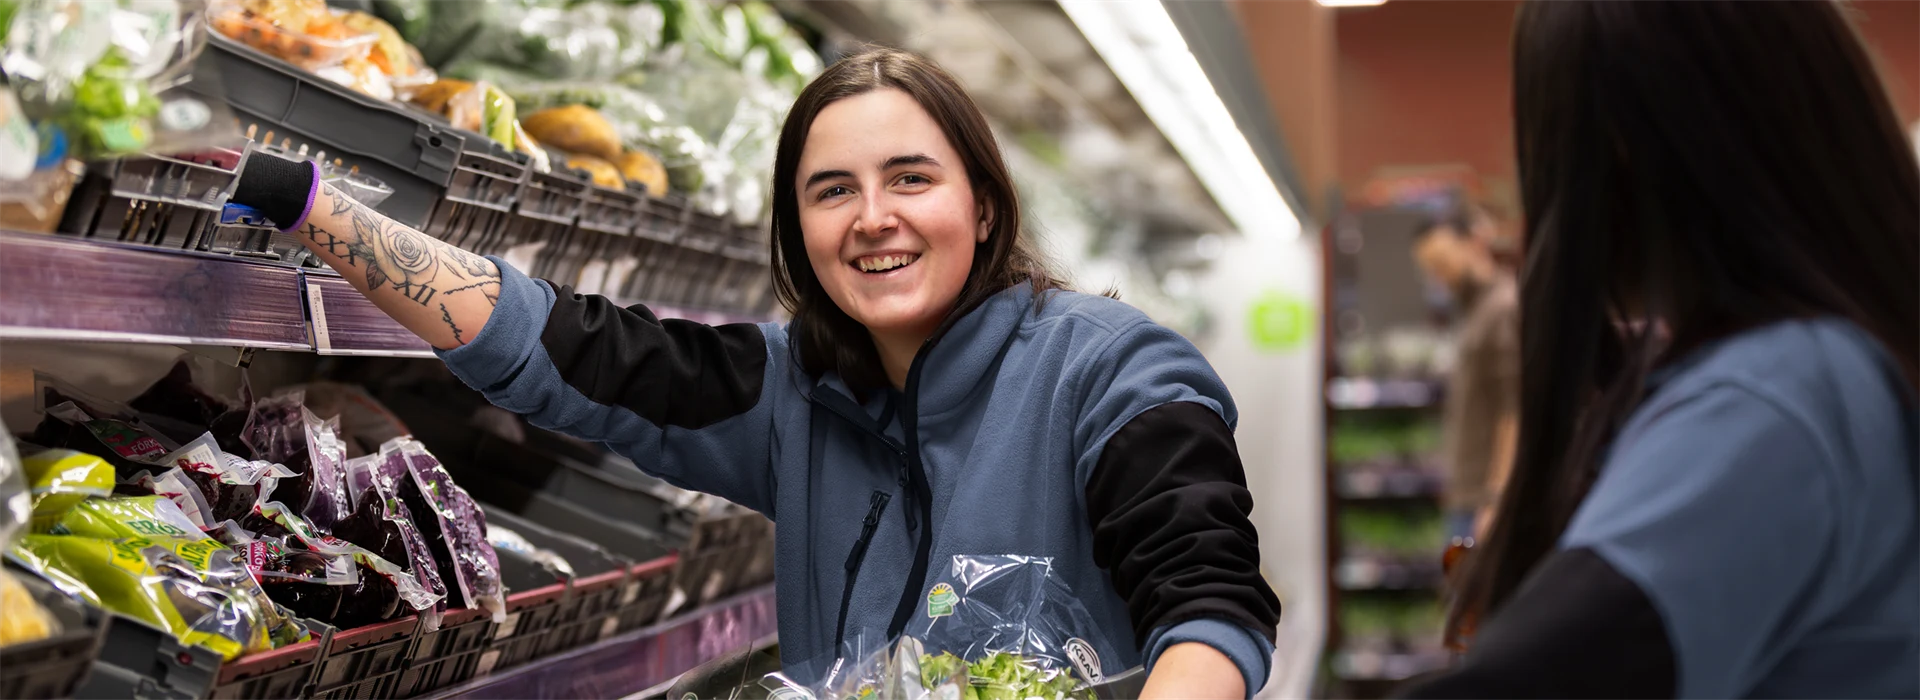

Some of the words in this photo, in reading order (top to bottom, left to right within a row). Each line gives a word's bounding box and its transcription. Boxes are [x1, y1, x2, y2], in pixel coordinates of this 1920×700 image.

[298, 223, 358, 267] XXX
[392, 278, 437, 307] XII
[1071, 644, 1099, 679] KRAV
